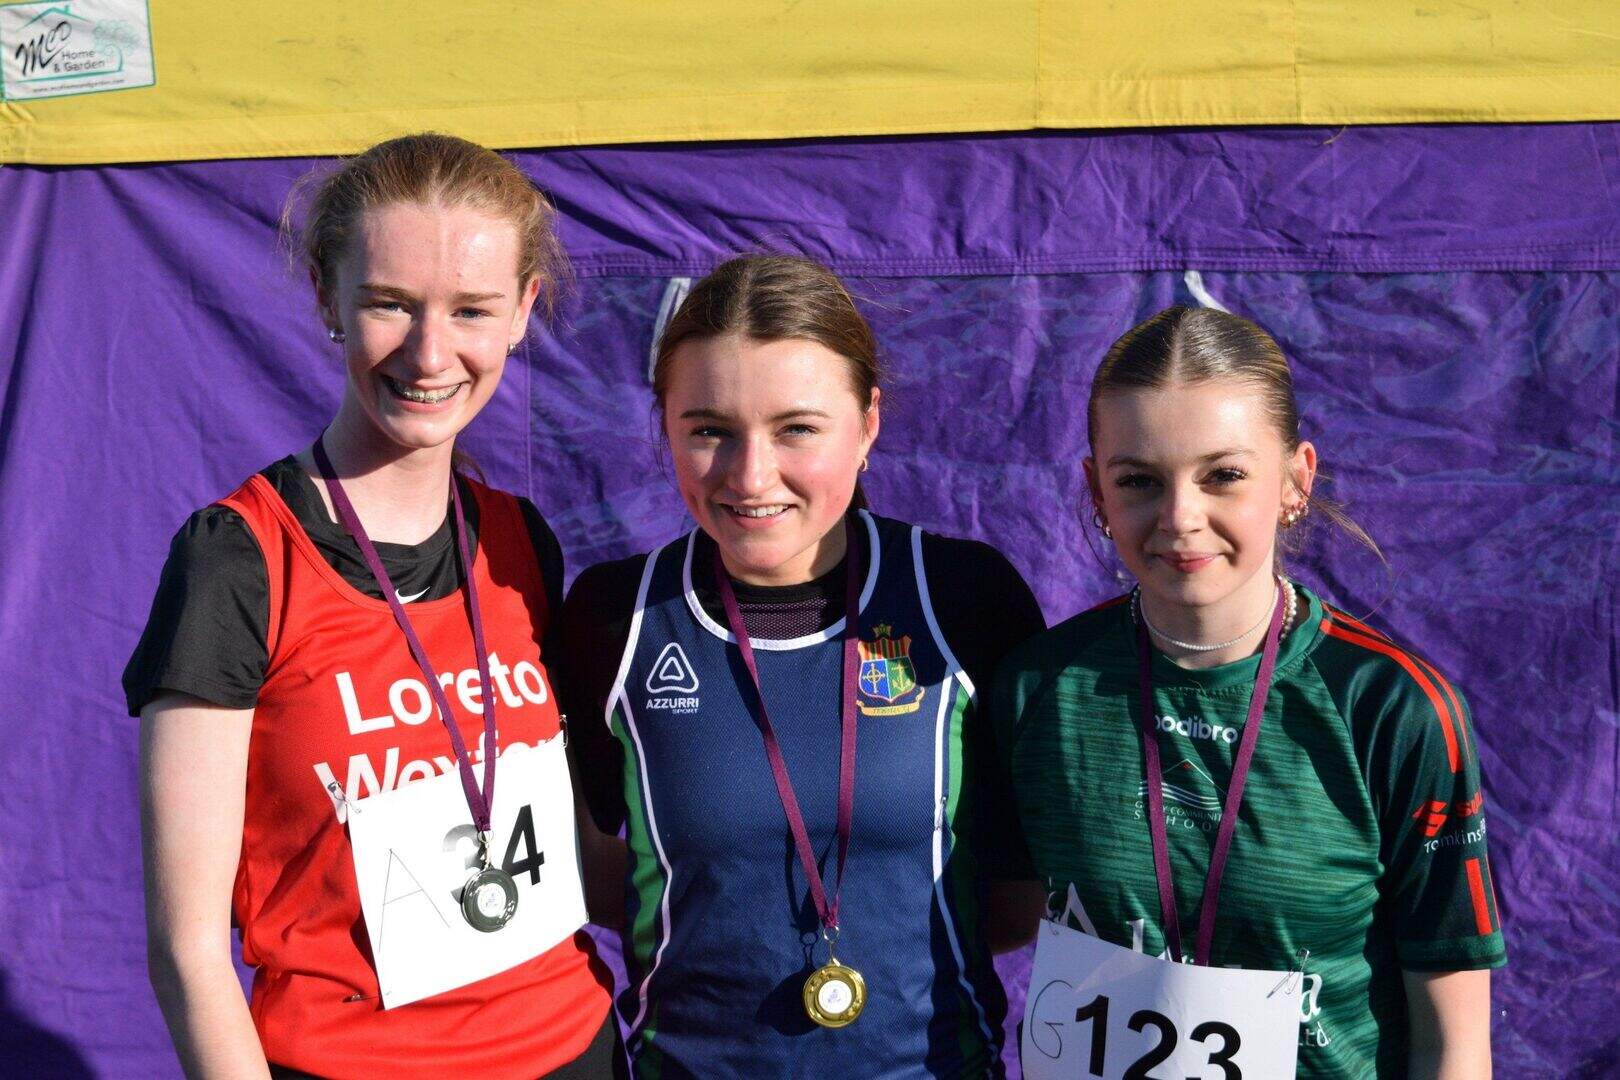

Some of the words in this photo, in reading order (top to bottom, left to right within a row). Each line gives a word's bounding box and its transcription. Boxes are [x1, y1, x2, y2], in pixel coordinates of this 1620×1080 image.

[62, 49, 95, 60] Home
[64, 59, 105, 72] Garden
[646, 697, 700, 710] AZZURRI
[1170, 806, 1223, 822] COMMUNIT
[1075, 994, 1242, 1080] 123
